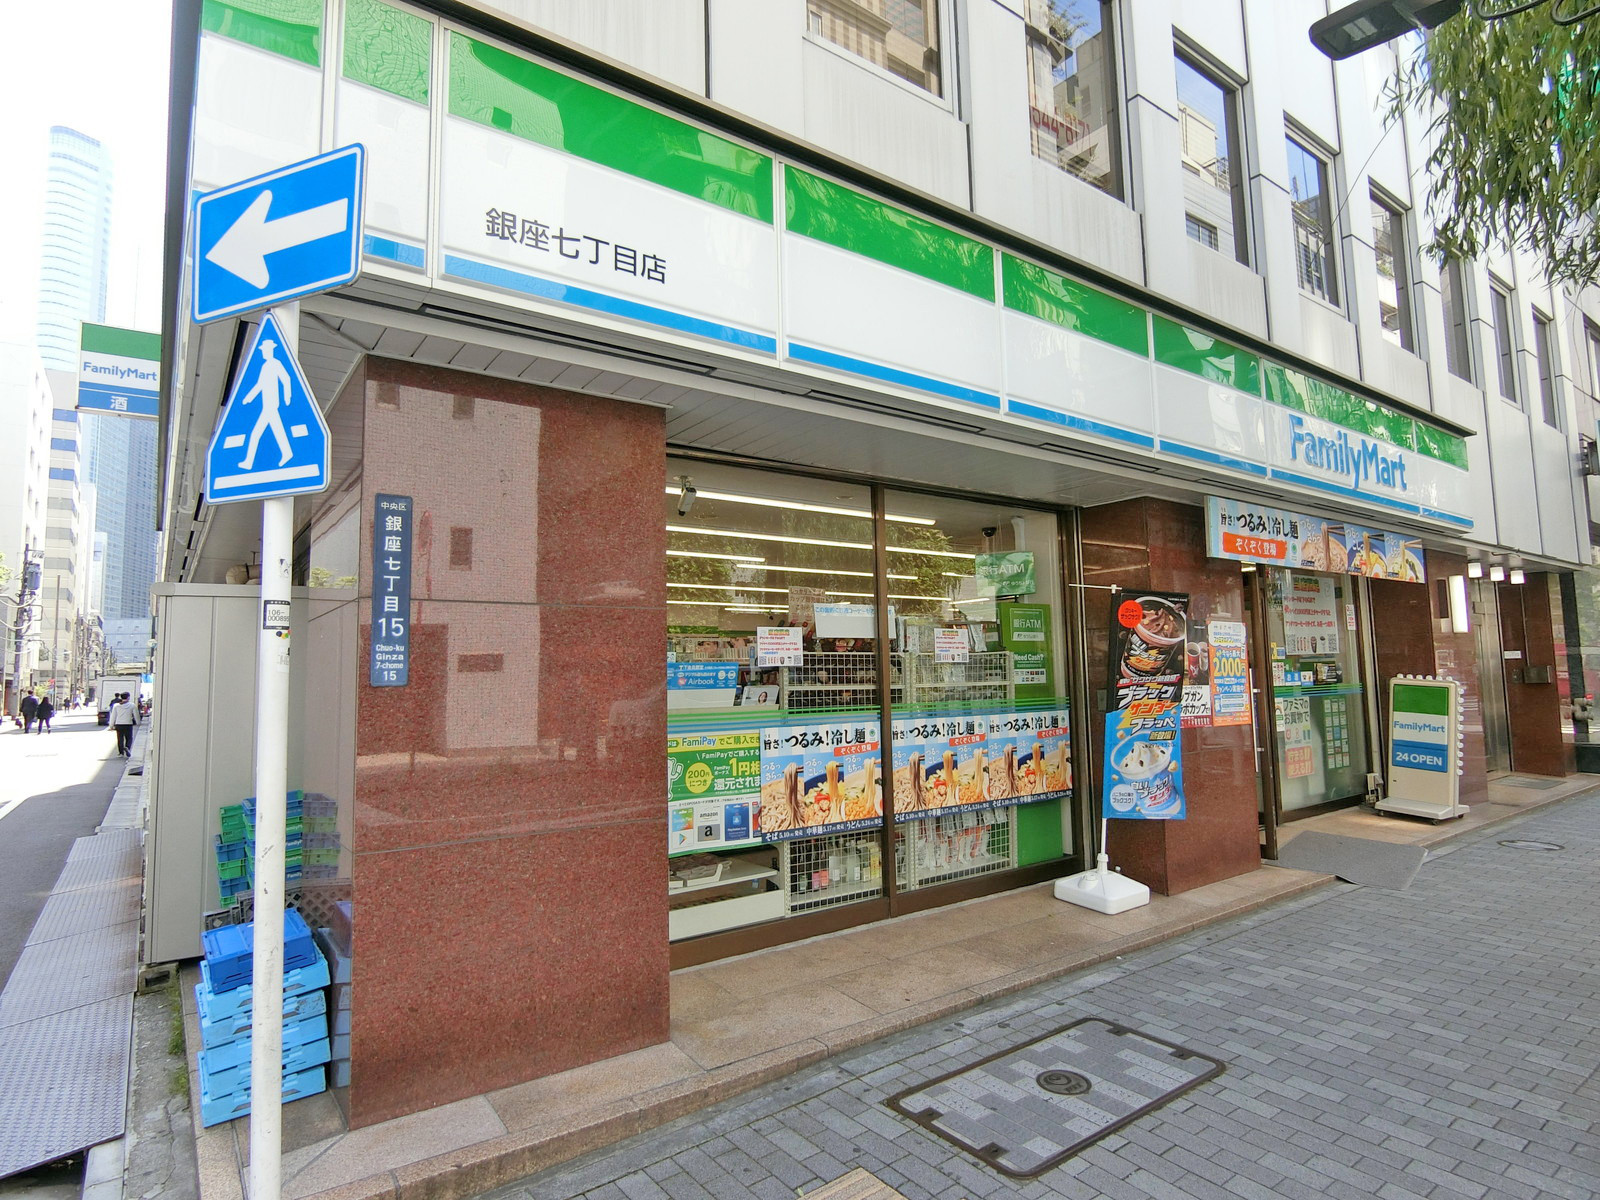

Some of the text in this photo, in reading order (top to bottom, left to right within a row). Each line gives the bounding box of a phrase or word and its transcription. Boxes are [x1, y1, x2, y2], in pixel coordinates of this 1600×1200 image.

[485, 207, 667, 284] 銀座七丁目店
[83, 361, 158, 381] FamilyMart
[110, 395, 128, 411] 酒
[1288, 413, 1407, 490] FamilyMart
[380, 502, 407, 511] 中央区
[1235, 537, 1277, 556] ぞくぞく登場
[378, 515, 404, 638] 銀座七丁目 15
[376, 644, 405, 652] Chuo-ku
[376, 653, 404, 661] Ginza
[383, 671, 397, 681] 15
[1117, 685, 1178, 710] ブラック
[1283, 699, 1310, 711] ファミマの
[1129, 701, 1179, 716] サンダー
[1284, 711, 1310, 725] お買物で
[1130, 716, 1176, 736] フラッペ
[1393, 720, 1446, 733] FamilyMart
[682, 736, 716, 747] FamiPay
[1396, 751, 1443, 766] 24 OPEN
[704, 825, 713, 837] a
